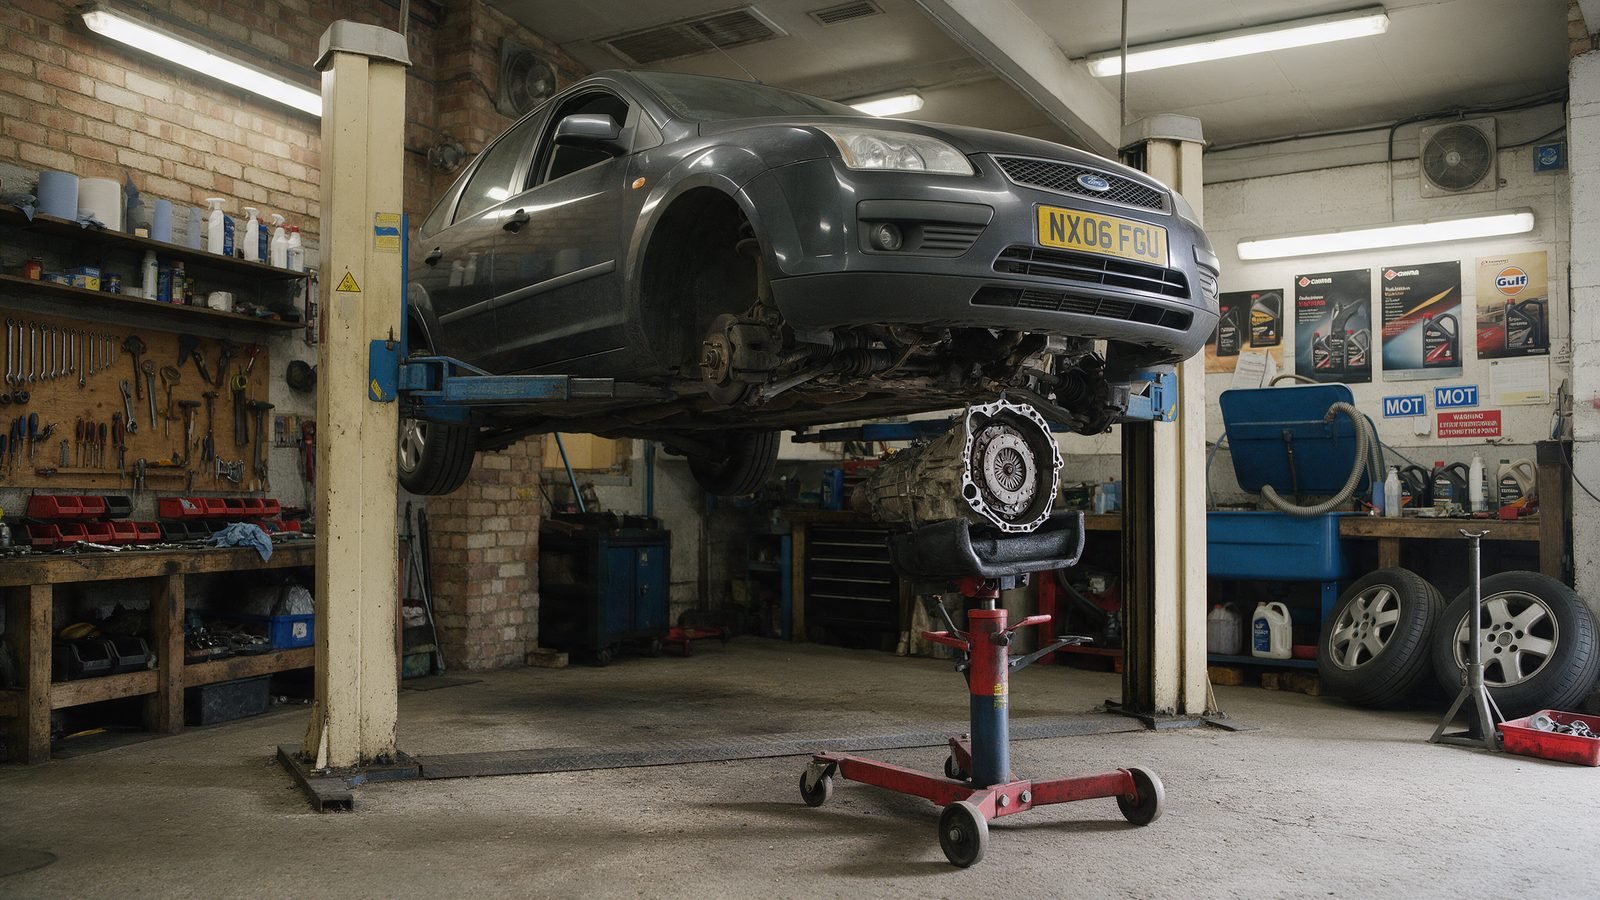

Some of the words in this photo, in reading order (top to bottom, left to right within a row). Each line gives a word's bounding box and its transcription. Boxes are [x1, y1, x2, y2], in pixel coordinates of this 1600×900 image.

[1050, 212, 1112, 249] NX06
[1119, 223, 1159, 259] FGU
[1497, 276, 1526, 287] Gulf
[1438, 388, 1475, 405] MOT
[1386, 398, 1422, 415] MOT
